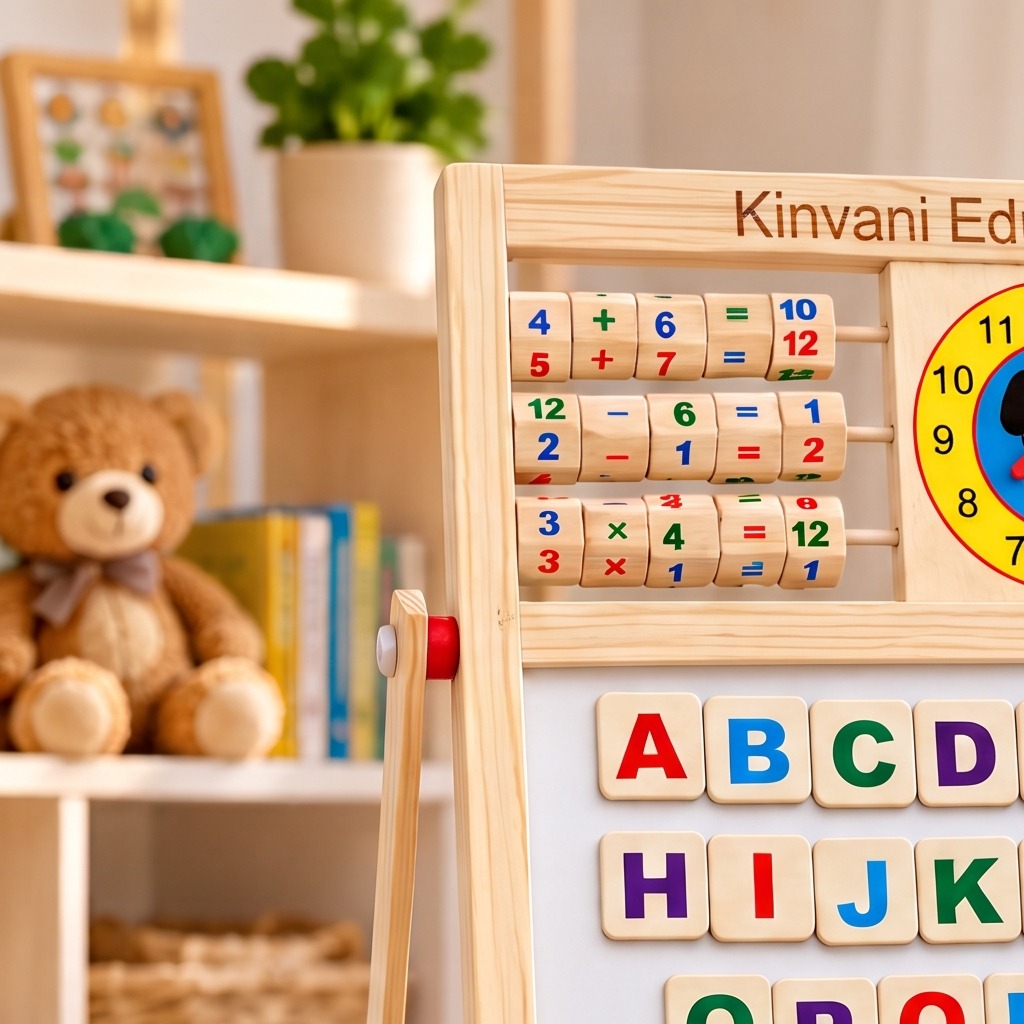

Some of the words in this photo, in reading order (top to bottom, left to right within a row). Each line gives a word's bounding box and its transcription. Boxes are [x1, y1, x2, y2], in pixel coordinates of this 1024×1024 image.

[736, 191, 928, 241] Kinvani
[528, 309, 550, 335] 4
[593, 309, 615, 331] +
[655, 312, 676, 338] 6
[726, 308, 748, 319] =
[780, 299, 816, 320] 10
[980, 316, 1011, 343] 11
[531, 353, 549, 377] 5
[592, 350, 613, 369] +
[657, 352, 676, 376] 7
[724, 352, 745, 363] =
[784, 330, 818, 356] 12
[934, 365, 973, 394] 10
[528, 398, 566, 419] 12
[674, 402, 696, 426] 6
[736, 407, 758, 417] =
[805, 399, 820, 423] 1
[538, 433, 559, 460] 2
[676, 441, 691, 465] 1
[738, 447, 760, 459] =
[803, 438, 824, 462] 2
[934, 425, 953, 454] 9
[959, 488, 977, 517] 8
[539, 511, 560, 536] 3
[663, 523, 685, 550] 4
[744, 526, 765, 538] =
[792, 521, 829, 547] 12
[538, 550, 559, 573] 3
[669, 564, 683, 582] 1
[741, 562, 764, 577] =
[804, 560, 818, 580] 1
[1006, 536, 1024, 565] 7
[616, 713, 687, 779] A
[728, 719, 789, 784] B
[833, 720, 896, 788] C
[935, 721, 996, 786] D
[623, 853, 687, 919] H
[753, 853, 774, 918] I
[837, 861, 887, 927] J
[934, 858, 1004, 924] K
